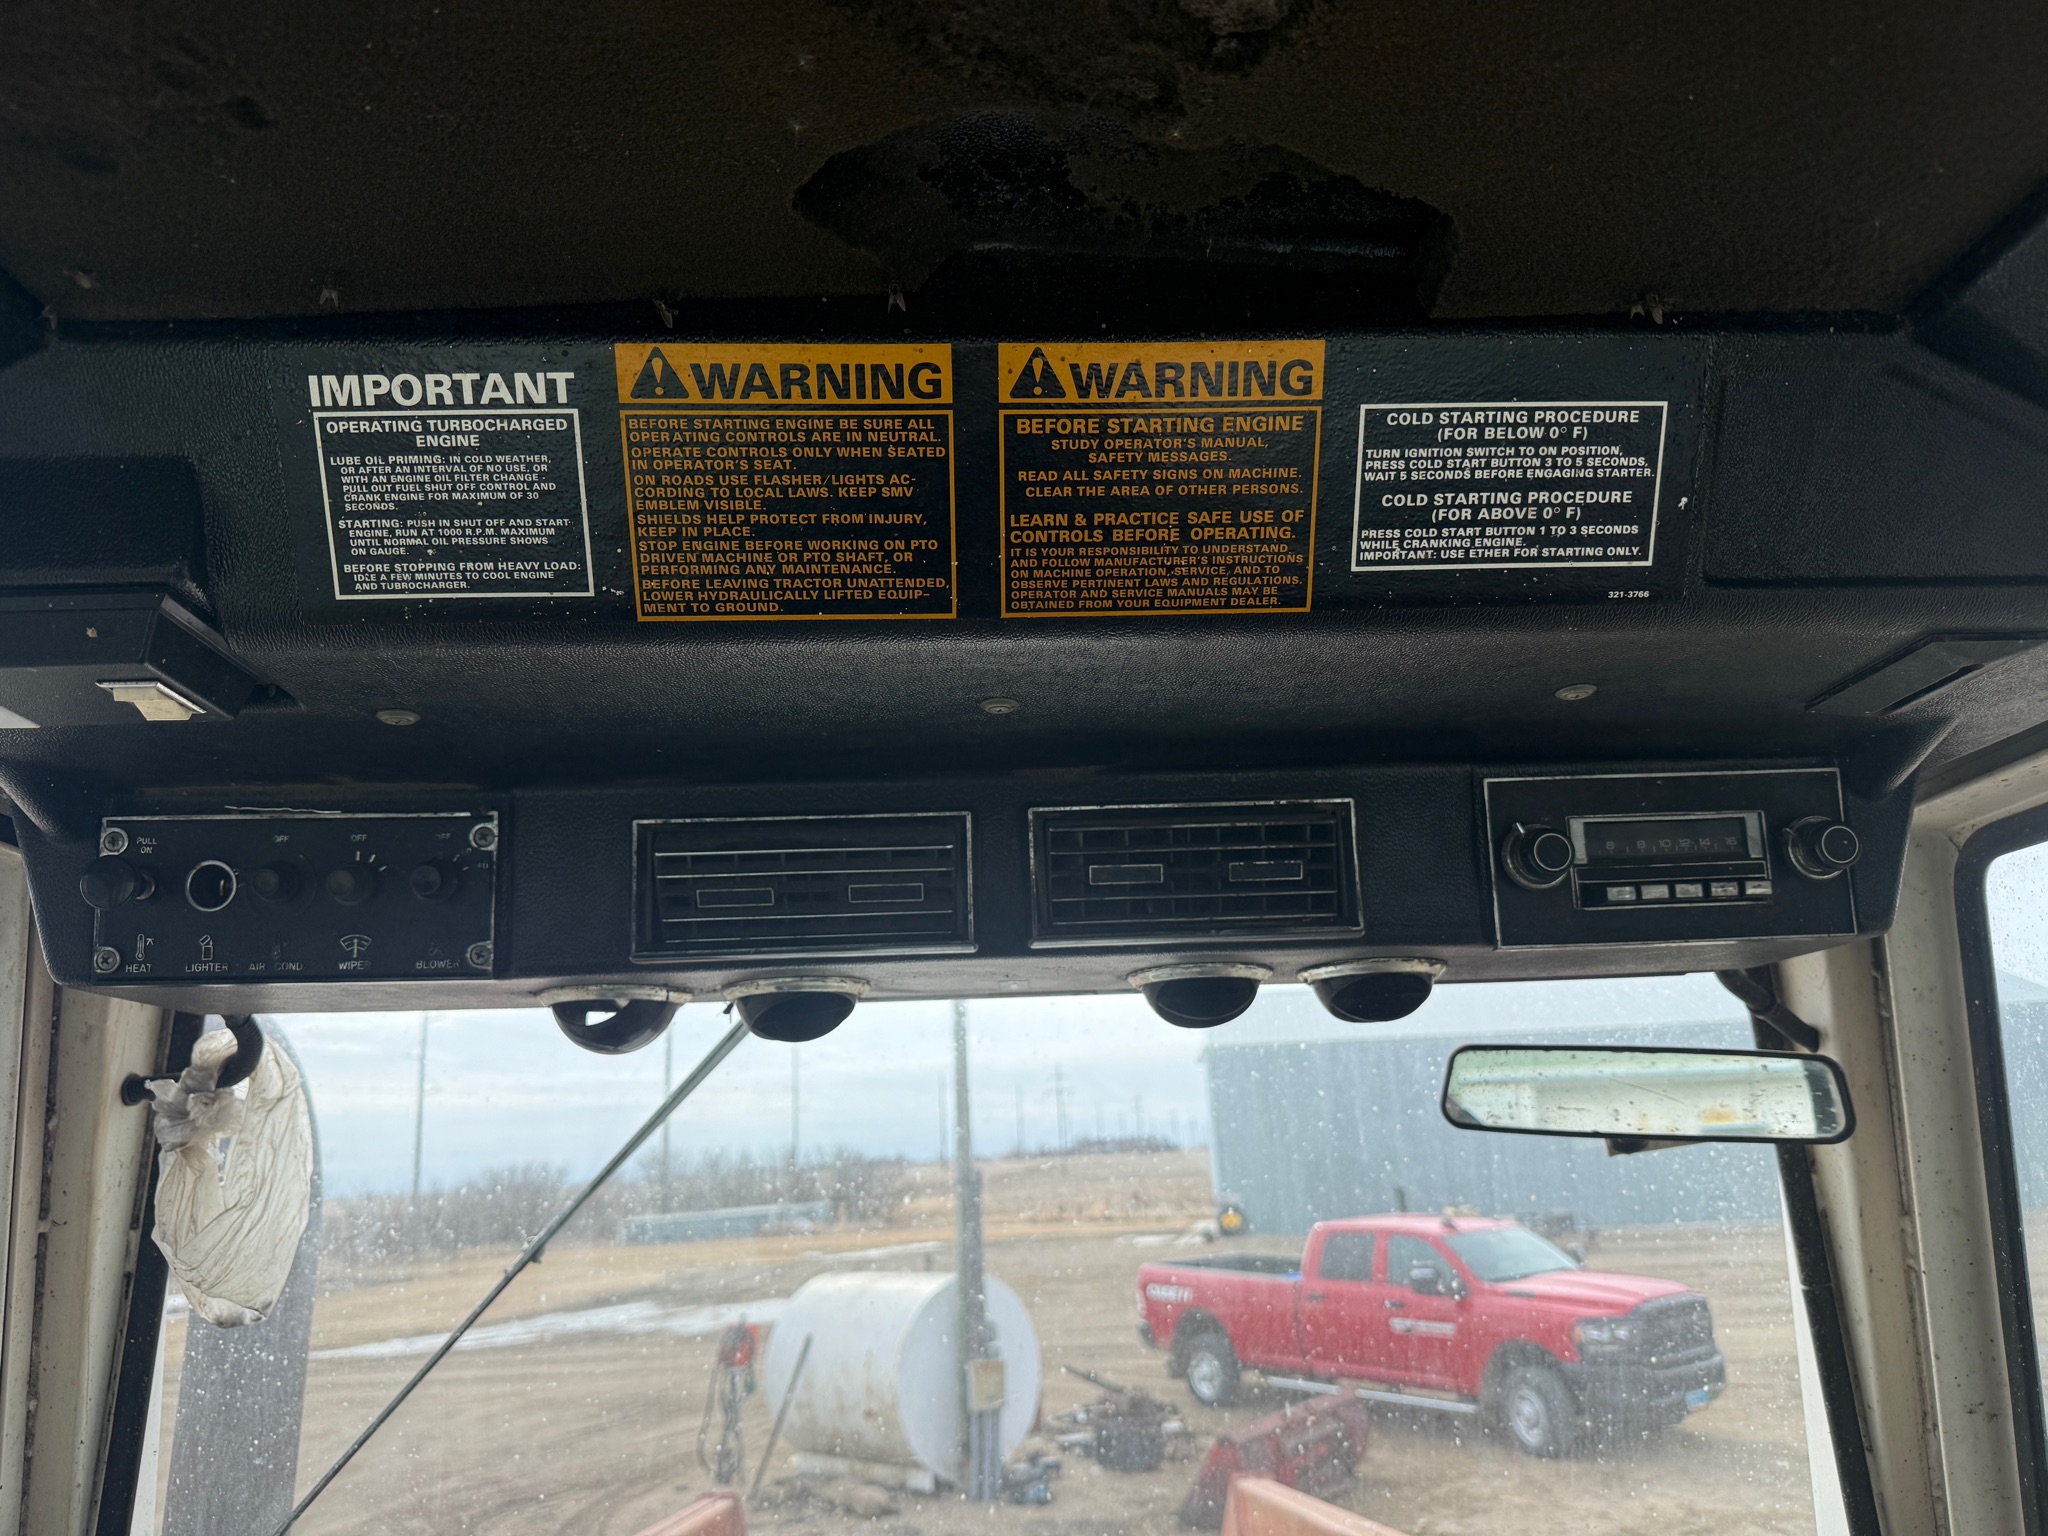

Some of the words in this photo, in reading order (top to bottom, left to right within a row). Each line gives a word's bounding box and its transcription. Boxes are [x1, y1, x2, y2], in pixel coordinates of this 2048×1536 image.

[689, 362, 943, 400] WARNING
[1068, 359, 1314, 399] WARNING
[308, 372, 575, 406] IMPORTANT
[628, 419, 688, 430] BEFORE
[693, 419, 770, 430] STARTING
[775, 419, 833, 430] ENGINE
[839, 419, 857, 430] BE
[863, 418, 902, 430] SURE
[907, 418, 935, 430] ALL
[1386, 413, 1433, 426] COLD
[1439, 412, 1527, 425] STARTING
[1534, 410, 1640, 424] PROCEDURE
[326, 420, 422, 434] OPERATING
[426, 418, 568, 432] TURBOCHARGED
[1016, 418, 1099, 435] BEFORE
[1107, 416, 1214, 433] STARTING
[1222, 415, 1304, 432] ENGINE
[629, 432, 720, 443] OPERATING
[725, 431, 806, 443] CONTROLS
[811, 431, 841, 443] ARE
[846, 431, 862, 443] IN
[867, 431, 942, 443] NEUTRAL.
[1437, 427, 1477, 442] (FOR
[1484, 426, 1544, 442] BELOW
[1572, 426, 1588, 441] F)
[416, 434, 480, 448] ENGINE
[1051, 439, 1099, 450] STUDY
[1104, 438, 1196, 450] OPERATOR'S
[1201, 437, 1269, 449] MANUAL,
[1088, 452, 1143, 463] SAFETY
[1148, 451, 1232, 463] MESSAGES.
[1365, 449, 1400, 459] TURN
[1404, 448, 1462, 459] IGNITION
[1466, 447, 1515, 458] SWITCH
[1518, 447, 1535, 458] TO
[1538, 447, 1557, 457] ON
[1560, 446, 1623, 457] POSITION,
[330, 456, 361, 466] LUBE
[364, 456, 385, 465] OIL
[388, 456, 445, 465] PRIMING:
[449, 455, 460, 464] IN
[464, 455, 492, 464] COLD
[494, 455, 551, 464] WEATHER,
[633, 474, 655, 486] ON
[661, 474, 714, 486] ROADS
[718, 474, 748, 485] USE
[754, 474, 884, 485] FLASHER/LIGHTS
[889, 474, 917, 485] AC-
[1017, 470, 1057, 482] READ
[1062, 470, 1088, 481] ALL
[1093, 469, 1148, 481] SAFETY
[1152, 469, 1197, 480] SIGNS
[1202, 468, 1223, 479] ON
[1228, 467, 1302, 479] MACHINE.
[344, 494, 381, 502] CRANK
[384, 493, 424, 502] ENGINE
[427, 493, 449, 501] FOR
[451, 492, 506, 501] MAXIMUM
[509, 492, 523, 501] OF
[526, 492, 540, 500] 30
[1025, 486, 1072, 498] CLEAR
[1076, 486, 1105, 497] THE
[1110, 485, 1150, 497] AREA
[1154, 485, 1173, 496] OF
[1178, 484, 1226, 496] OTHER
[1232, 484, 1303, 495] PERSONS.
[1381, 494, 1428, 507] COLD
[1433, 493, 1521, 506] STARTING
[1527, 491, 1633, 505] PROCEDURE
[344, 502, 399, 511] SECONDS.
[637, 514, 701, 525] SHIELDS
[706, 514, 745, 525] HELP
[750, 514, 817, 525] PROTECT
[822, 514, 863, 525] FROM
[869, 514, 928, 525] INJURY,
[1010, 513, 1068, 527] LEARN
[1074, 513, 1086, 526] &
[1093, 512, 1179, 526] PRACTICE
[1187, 511, 1231, 525] SAFE
[1239, 510, 1273, 524] USE
[1281, 510, 1305, 523] OF
[1431, 507, 1471, 523] (FOR
[1477, 507, 1537, 523] ABOVE
[1565, 506, 1581, 521] F)
[338, 519, 403, 529] STARTING:
[406, 519, 435, 528] PUSH
[438, 519, 450, 528] IN
[453, 519, 482, 528] SHUT
[485, 519, 505, 528] OFF
[508, 518, 532, 528] AND
[535, 518, 570, 527] START
[1010, 529, 1103, 543] CONTROLS
[1112, 528, 1179, 542] BEFORE
[1190, 526, 1296, 541] OPERATING.
[350, 538, 381, 546] UNTIL
[383, 538, 429, 546] NORMAL
[431, 538, 449, 546] OIL
[451, 537, 506, 546] PRESSURE
[509, 537, 549, 545] SHOWS
[638, 541, 677, 551] STOP
[682, 541, 739, 551] ENGINE
[745, 540, 802, 551] BEFORE
[807, 540, 878, 551] WORKING
[883, 540, 905, 550] ON
[910, 540, 939, 550] PTO
[1359, 550, 1436, 561] IMPORTANT:
[1440, 549, 1465, 560] USE
[1469, 549, 1509, 559] ETHER
[1513, 548, 1537, 559] FOR
[1541, 547, 1603, 558] STARTING
[1606, 546, 1642, 557] ONLY.
[1010, 558, 1037, 568] AND
[1042, 557, 1090, 567] FOLLOW
[1094, 556, 1208, 567] MANUFACTURER'S
[1212, 554, 1304, 565] INSTRUCTIONS
[343, 564, 390, 573] BEFORE
[394, 563, 455, 573] STOPPING
[459, 563, 494, 572] FROM
[498, 562, 539, 571] HEAVY
[544, 562, 581, 571] LOAD:
[354, 582, 378, 591] AND
[641, 579, 700, 590] BEFORE
[705, 579, 768, 590] LEAVING
[773, 578, 841, 589] TRACTOR
[846, 578, 950, 589] UNATTENDED,
[642, 591, 693, 601] LOWER
[697, 590, 818, 601] HYDRAULICALLY
[823, 590, 872, 600] LIFTED
[878, 589, 930, 600] EQUIP-
[1607, 591, 1650, 599] 321-3766
[1010, 599, 1074, 610] OBTAINED
[1078, 599, 1112, 609] FROM
[1116, 598, 1149, 608] YOUR
[1154, 597, 1226, 608] EQUIPMENT
[1230, 597, 1281, 607] DEALER.
[136, 837, 157, 845] PULL
[273, 835, 289, 843] OFF
[351, 834, 367, 842] OFF
[1658, 839, 1671, 848] 10
[1679, 839, 1691, 847] 12
[1698, 837, 1711, 846] 14
[141, 846, 152, 854] ON
[125, 964, 152, 973] HEAT
[185, 963, 228, 972] LIGHTER
[249, 962, 265, 971] AIR
[417, 960, 460, 969] BLOWER
